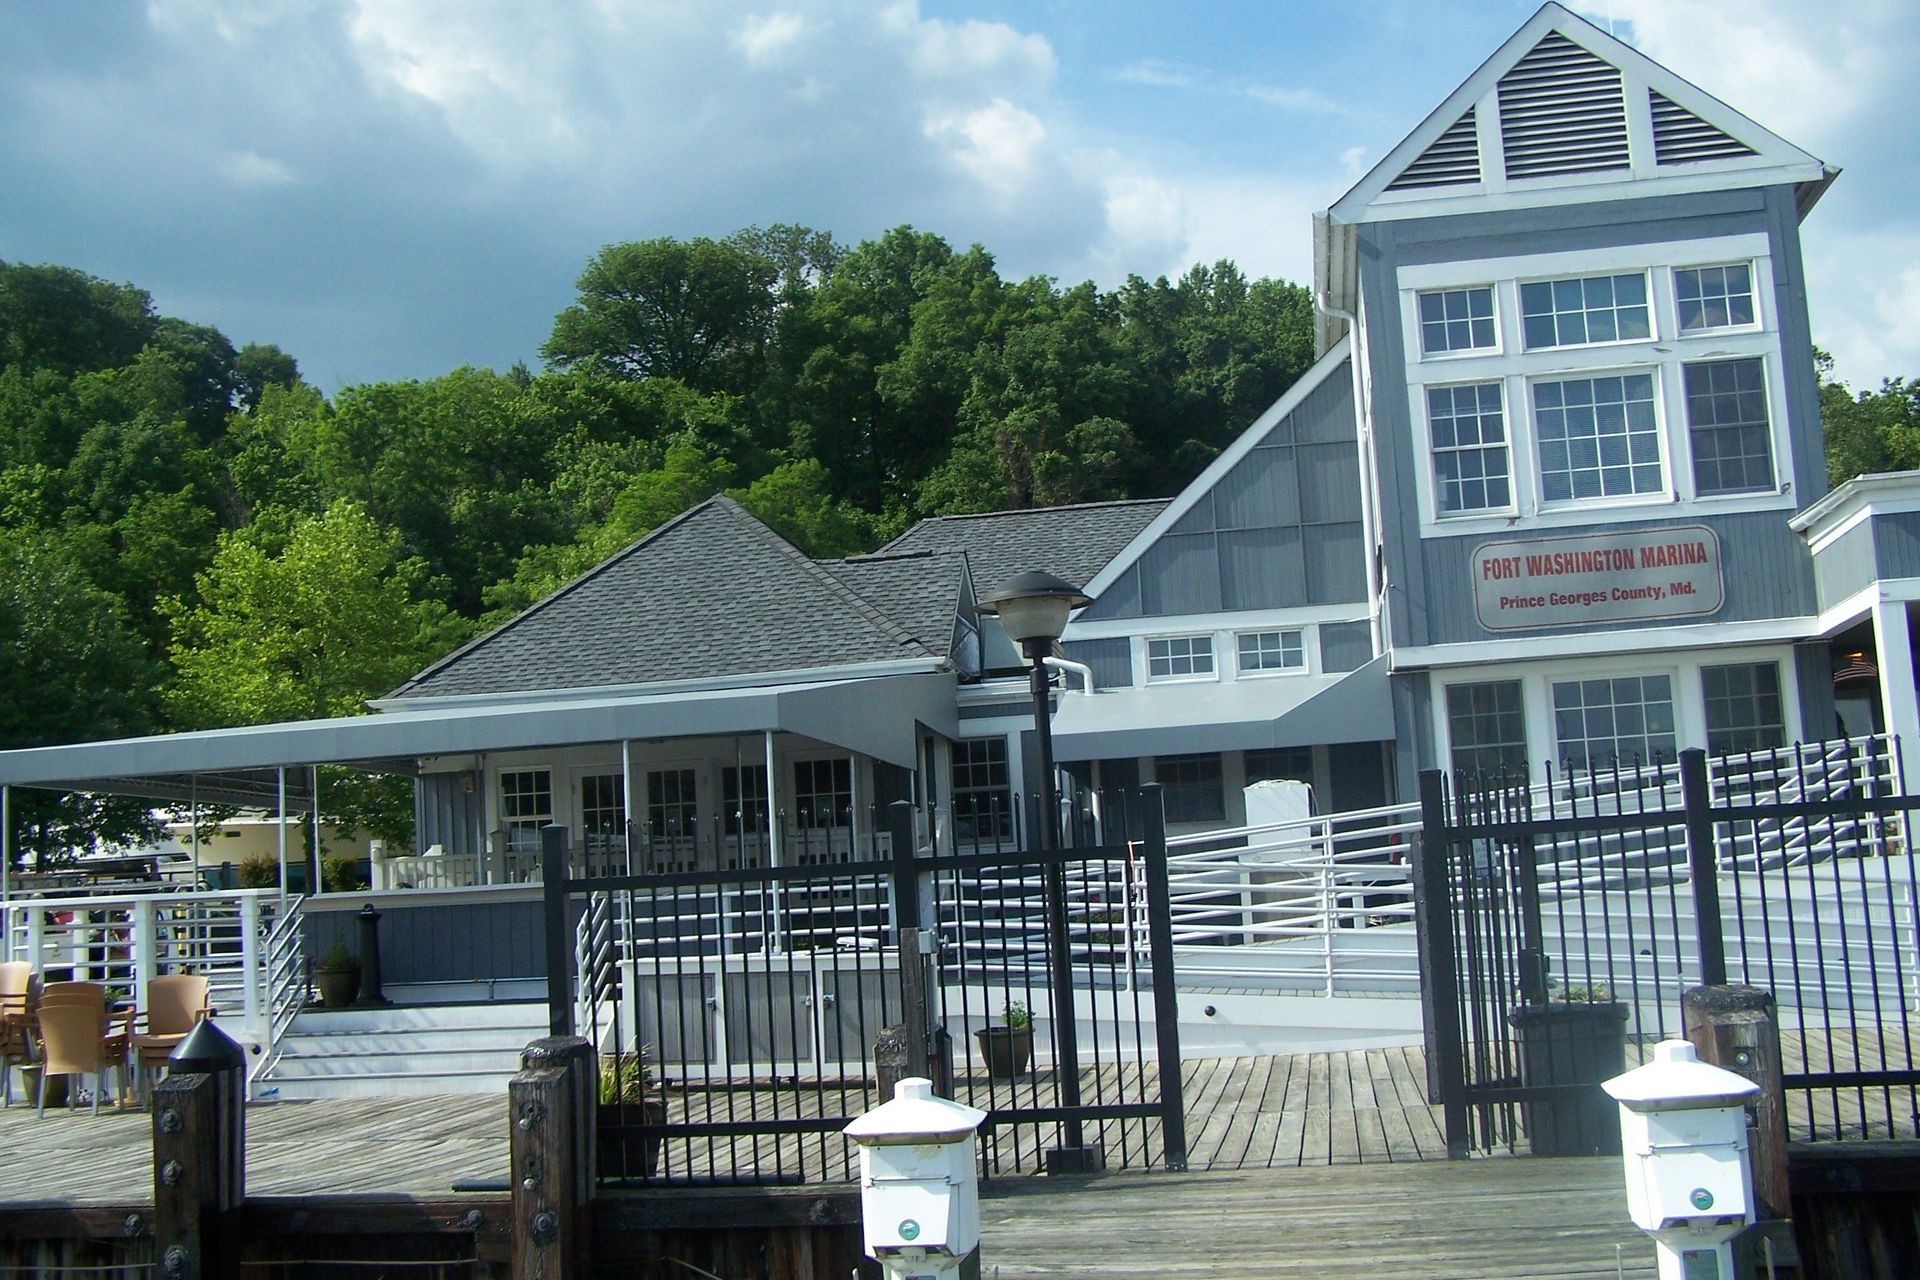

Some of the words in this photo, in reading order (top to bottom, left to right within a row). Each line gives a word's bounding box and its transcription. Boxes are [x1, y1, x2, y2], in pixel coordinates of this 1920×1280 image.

[1482, 556, 1521, 581] FORT
[1526, 549, 1635, 577] WASHINGTON
[1640, 542, 1708, 569] MARINA
[1500, 595, 1545, 610] Prince
[1549, 590, 1607, 606] Georges
[1611, 585, 1666, 601] County,
[1669, 581, 1697, 596] Md.
